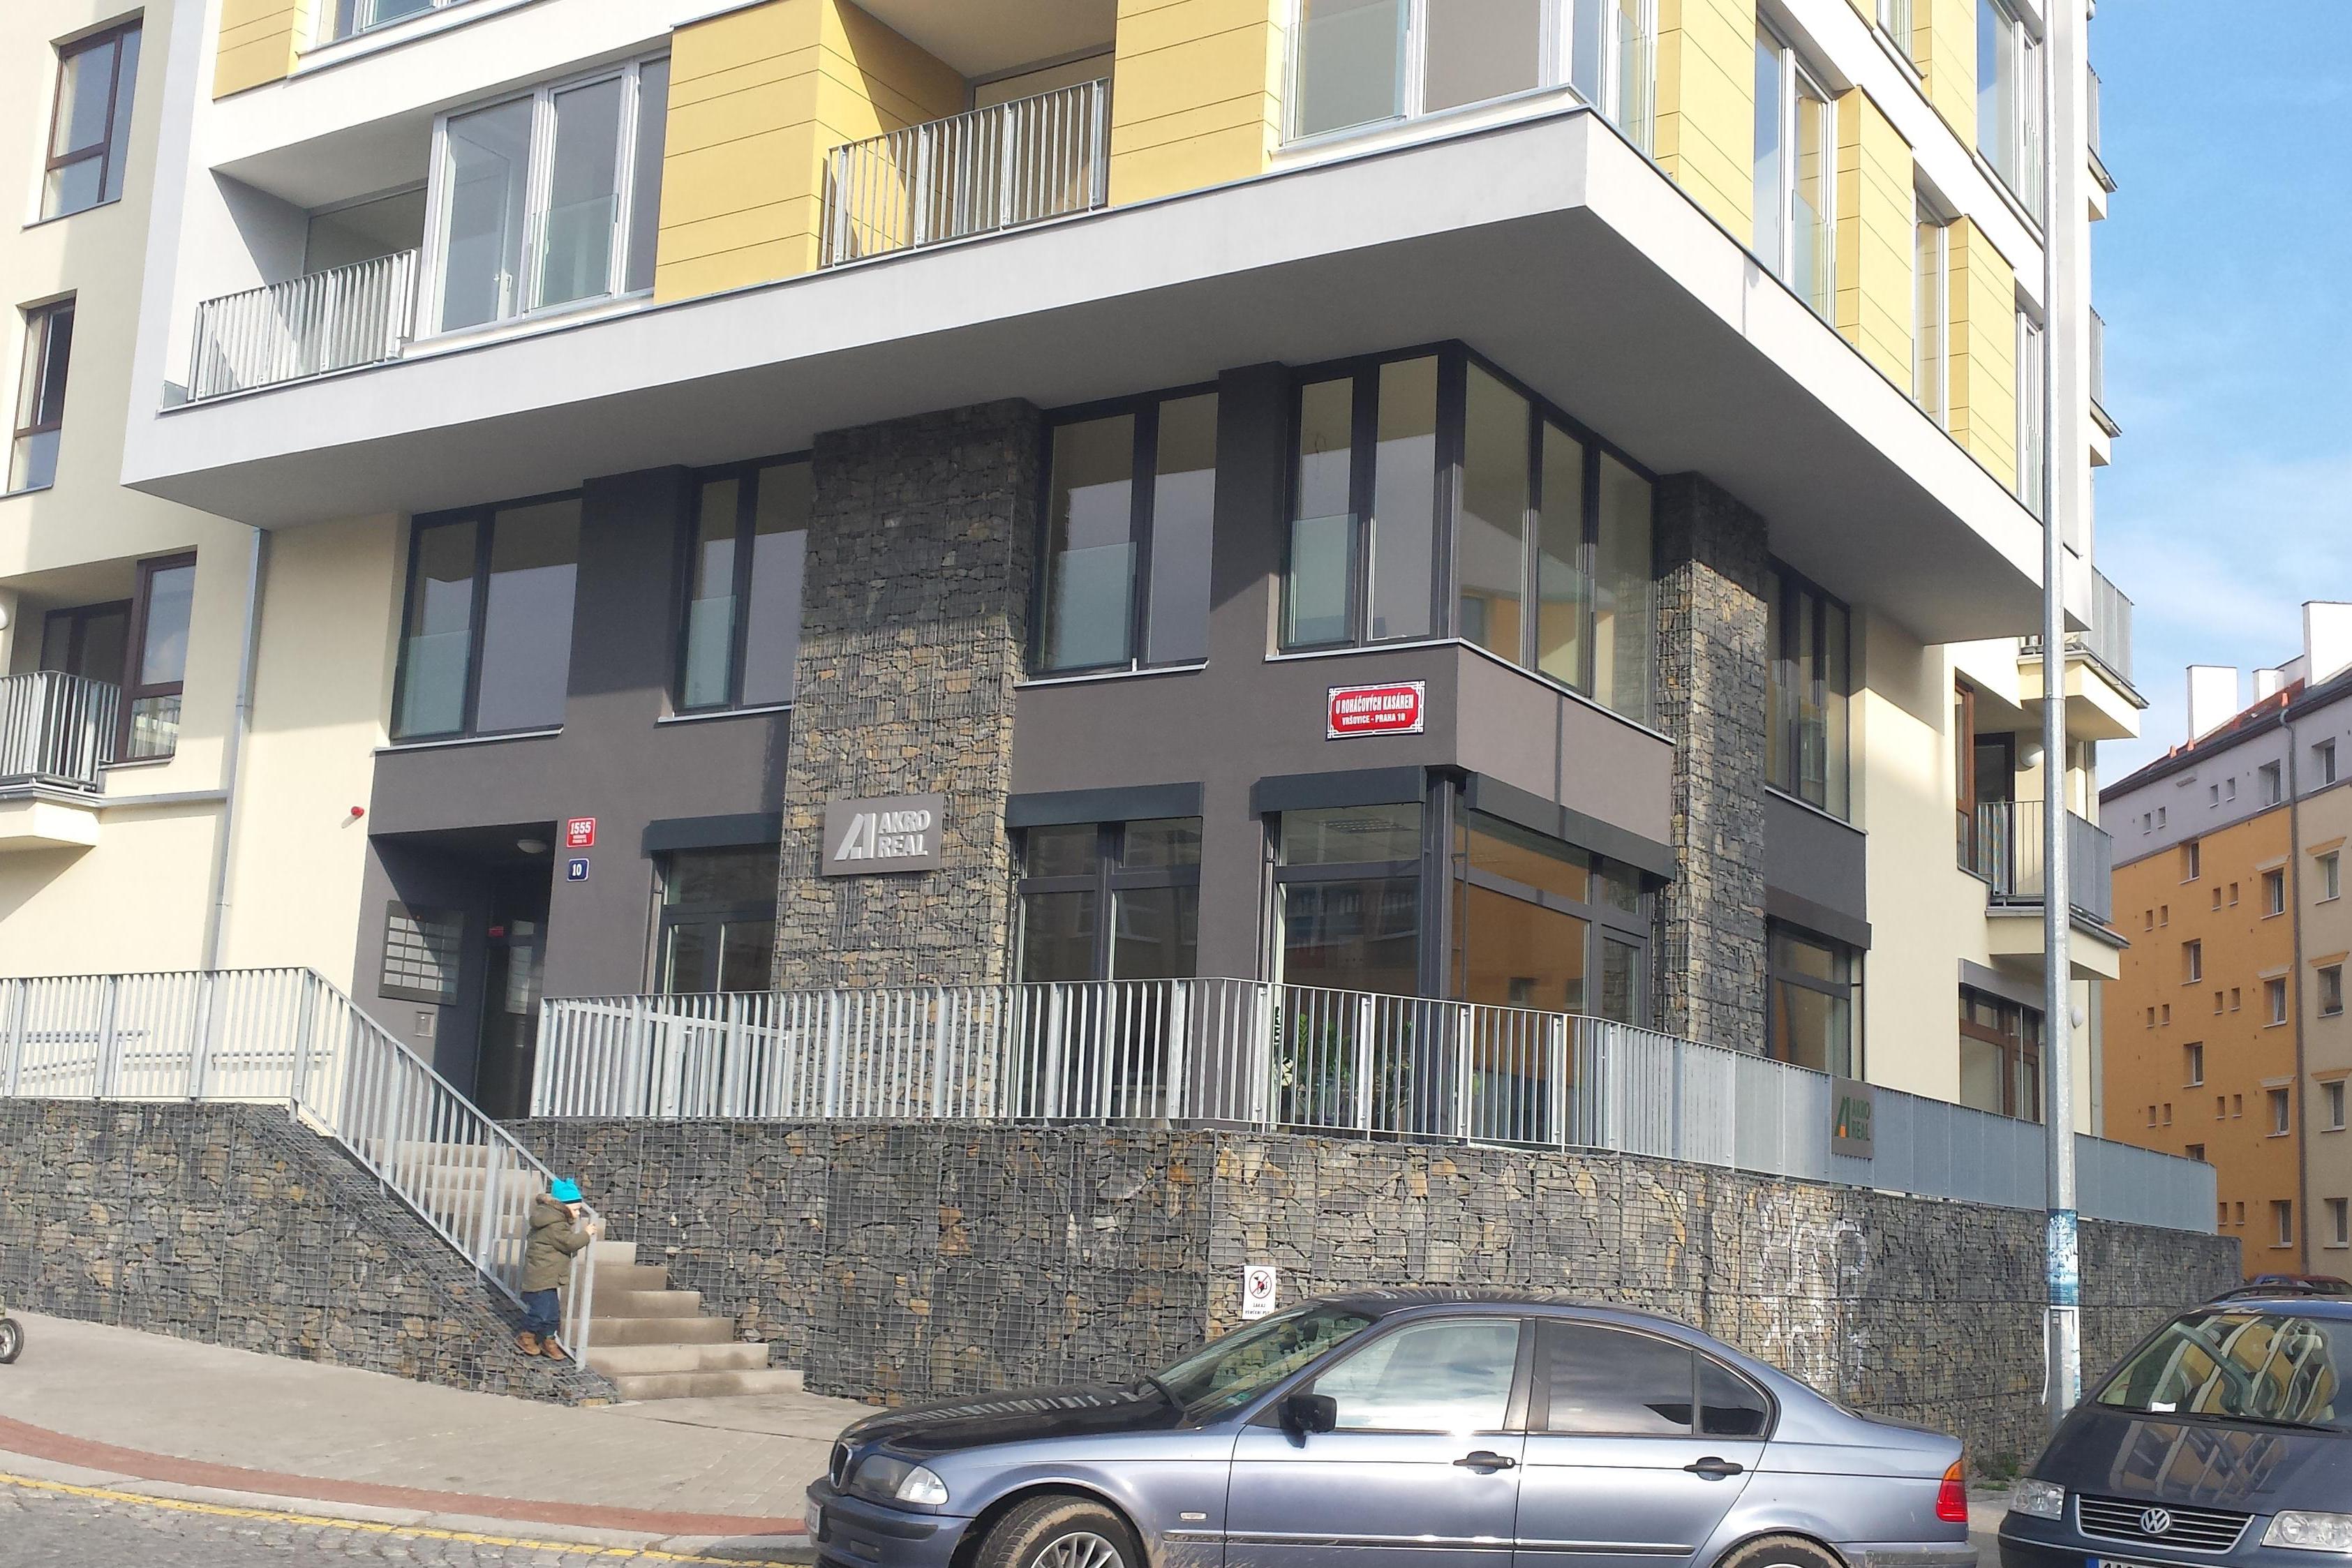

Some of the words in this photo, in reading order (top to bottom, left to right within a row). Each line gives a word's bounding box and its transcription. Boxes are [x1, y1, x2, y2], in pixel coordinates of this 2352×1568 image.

[1336, 700, 1341, 715] U
[1383, 693, 1414, 710] KASÁREN
[1342, 715, 1370, 726] VRŠOVICE
[1375, 713, 1396, 723] PRAHA
[1397, 712, 1406, 722] 10
[570, 821, 591, 835] 1555
[878, 809, 930, 834] AKRO
[877, 834, 928, 859] REAL
[572, 863, 582, 876] 10
[1852, 1120, 1870, 1141] REAL
